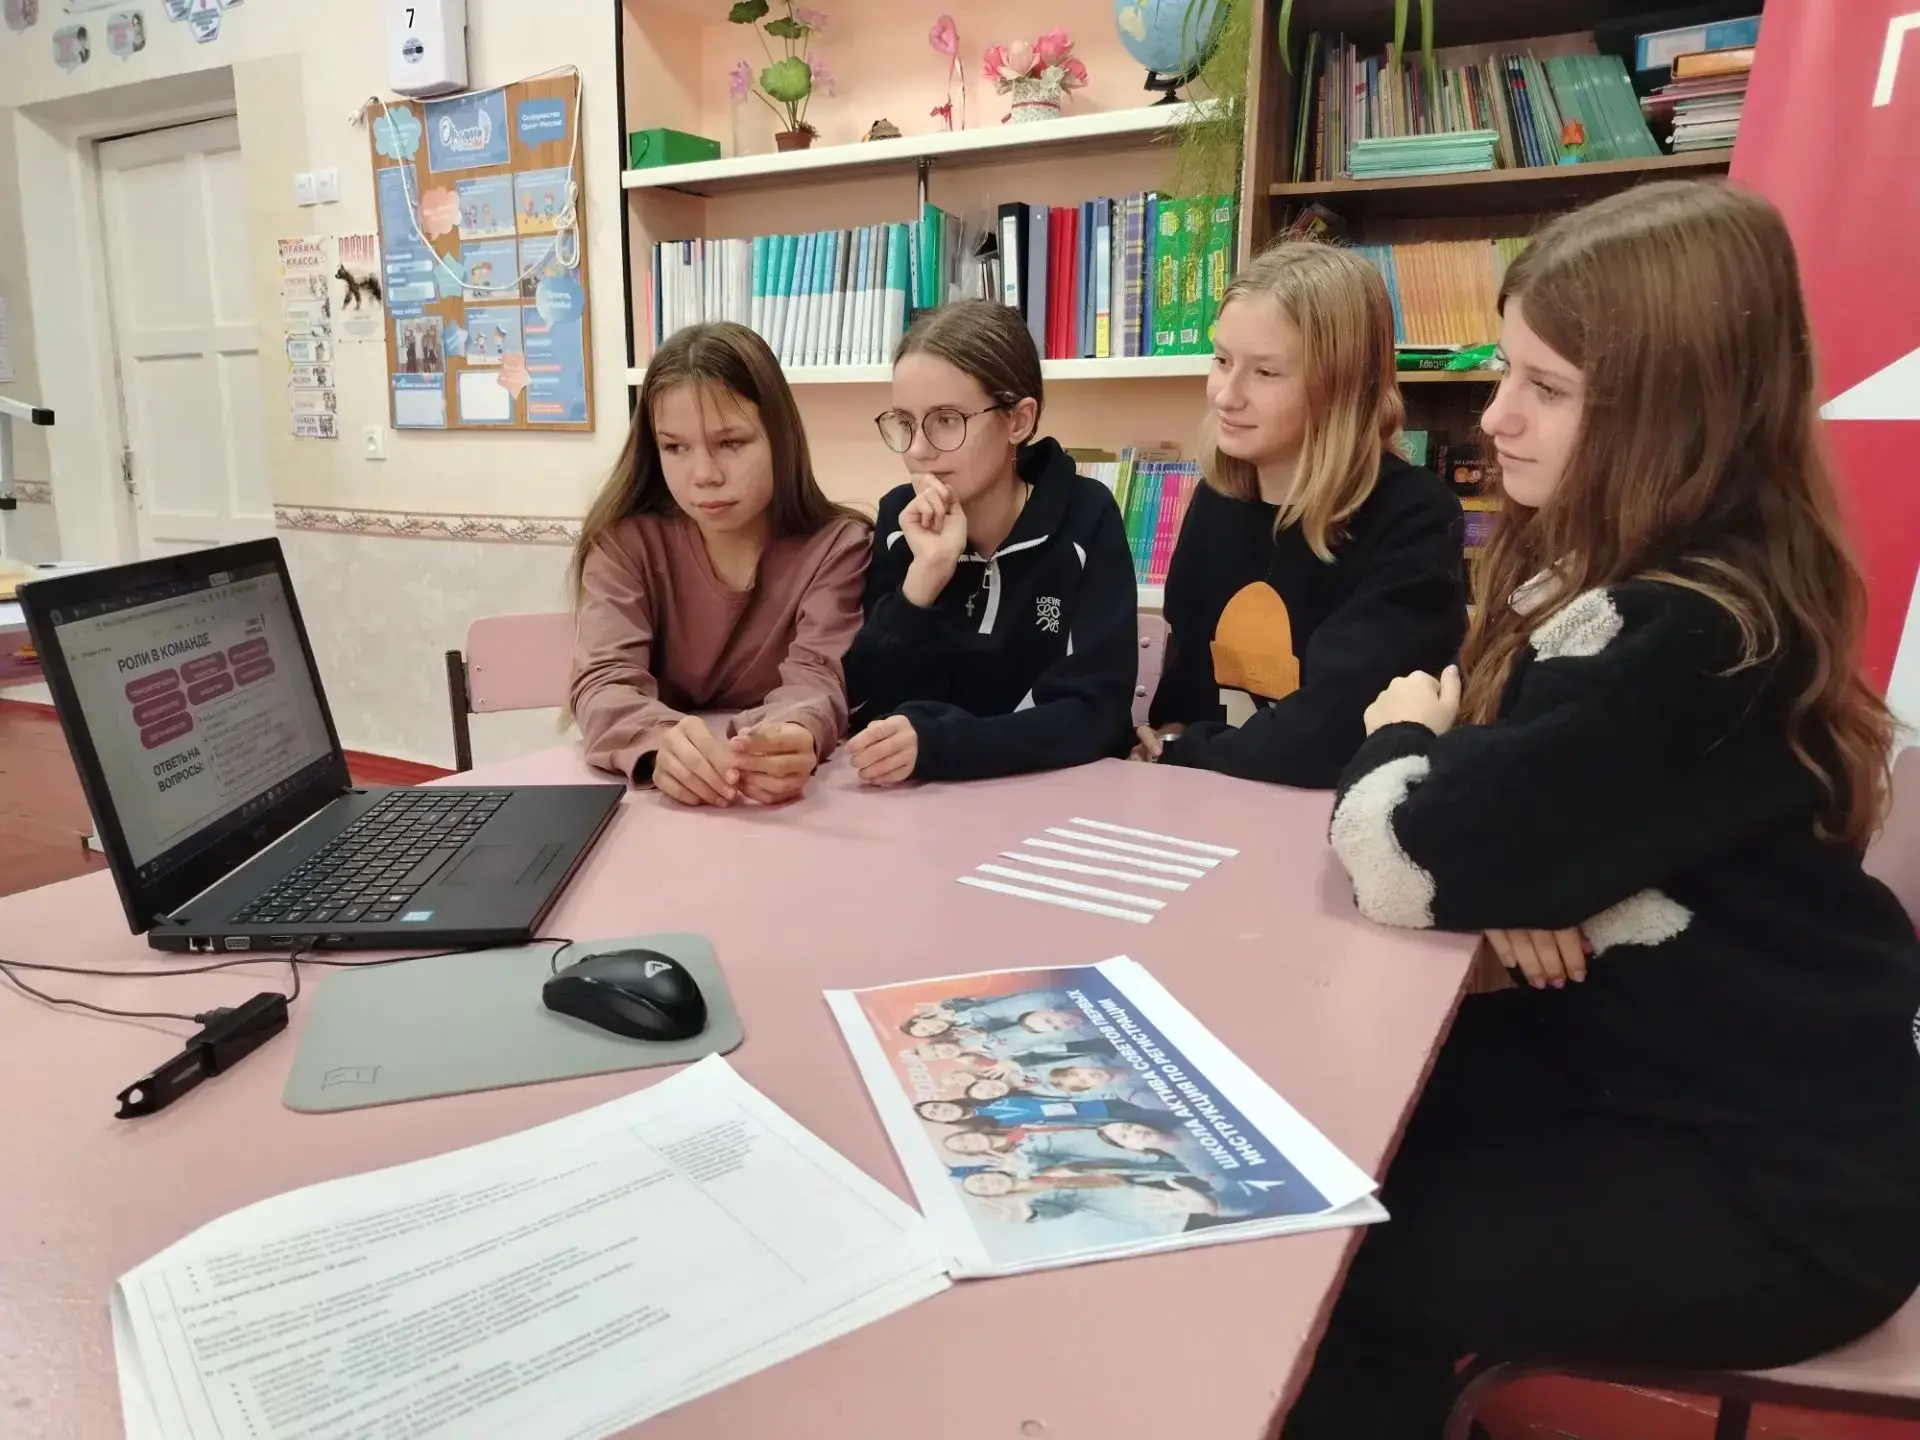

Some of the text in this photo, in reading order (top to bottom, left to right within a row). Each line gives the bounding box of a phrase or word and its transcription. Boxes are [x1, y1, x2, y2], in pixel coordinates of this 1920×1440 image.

[406, 8, 415, 29] 7
[283, 244, 321, 254] ПРАВИЛА
[286, 256, 319, 267] КЛАССА
[1036, 596, 1061, 607] LOEWE
[117, 632, 211, 673] РОЛИ В КОМАНДЕ
[153, 746, 200, 776] ОТВЕТЬ НА
[1065, 989, 1240, 1169] ШКОЛА АКТИВА СОВЕТОВ ПЕРВЫХ
[1097, 998, 1267, 1166] ИНСТРУКЦИЯ ПО РЕГИСТРАЦИИ
